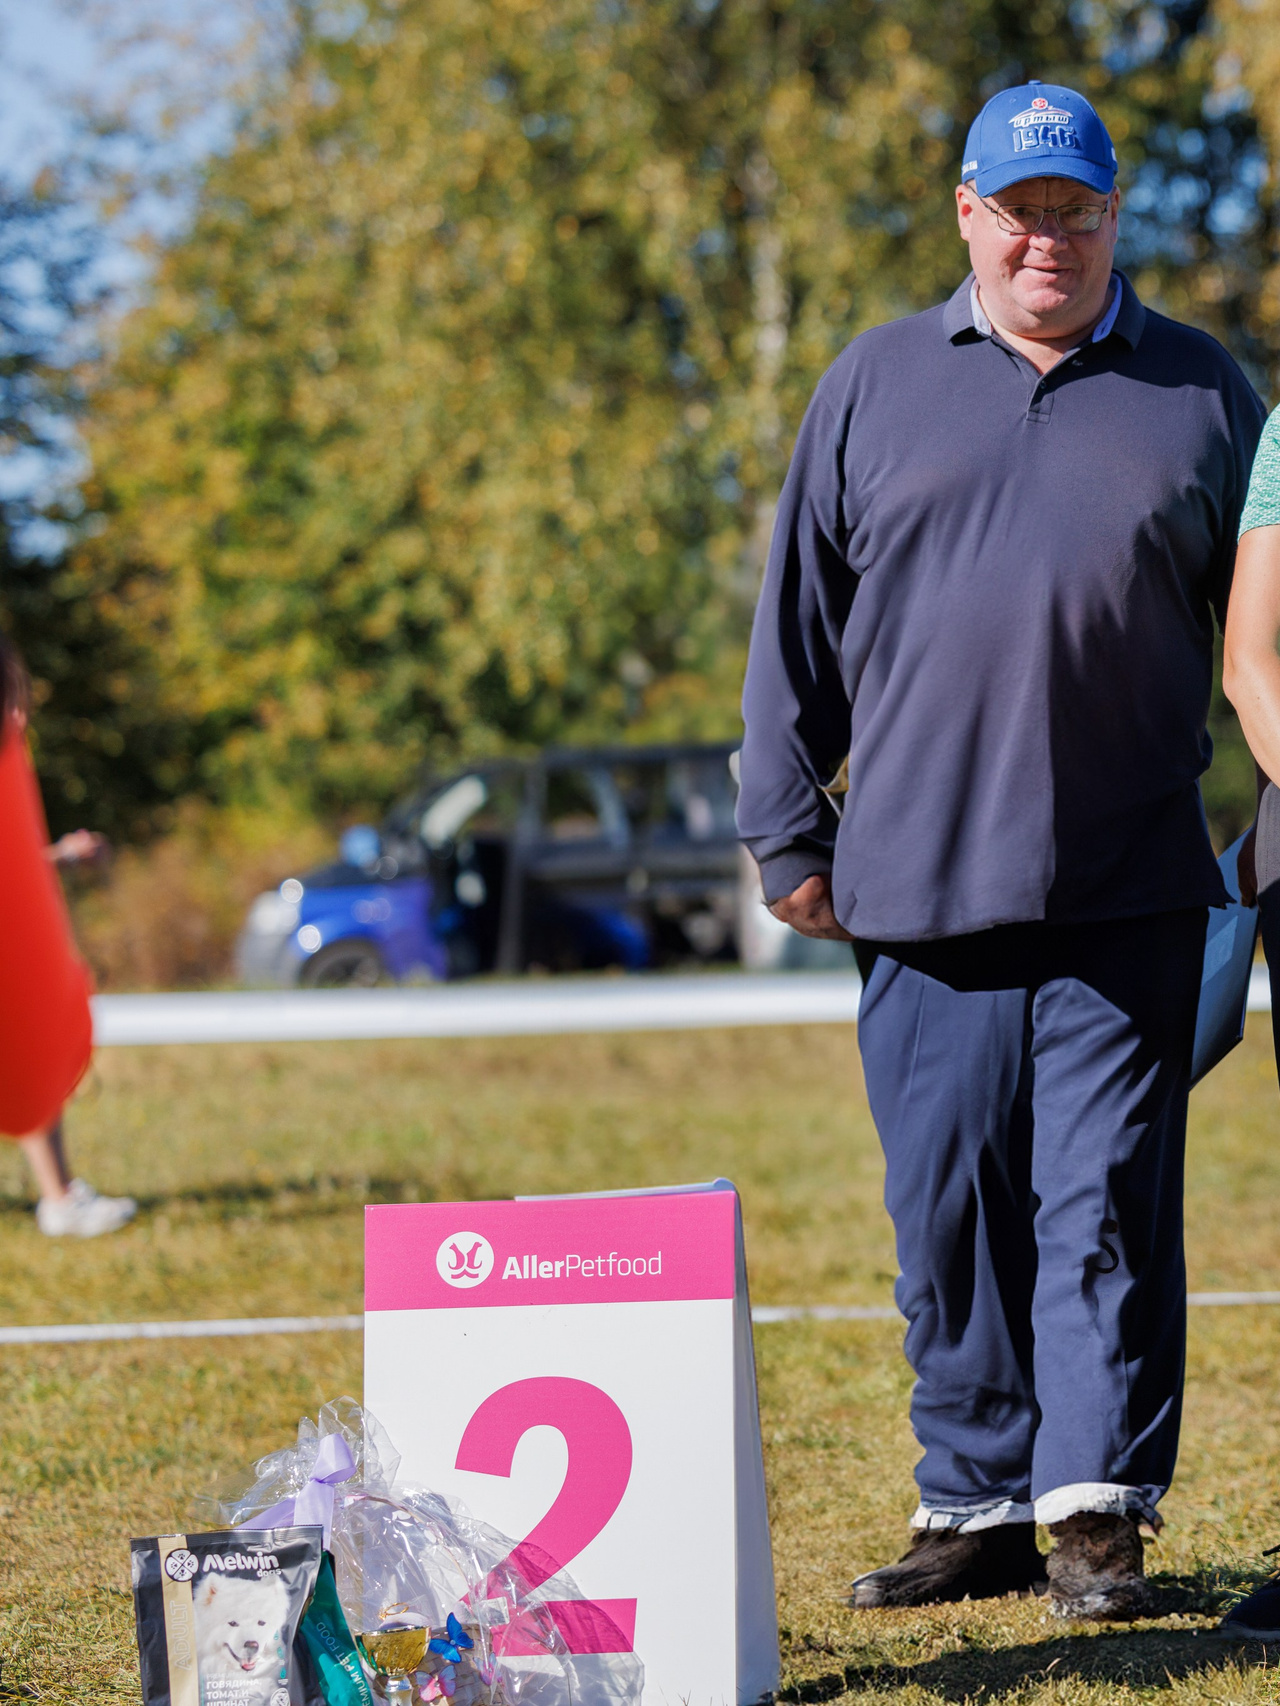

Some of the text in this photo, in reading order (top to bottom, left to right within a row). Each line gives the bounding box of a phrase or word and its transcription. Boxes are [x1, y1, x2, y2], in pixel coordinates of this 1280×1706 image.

[1013, 125, 1076, 152] 1946
[502, 1250, 662, 1280] AllerPetfood
[455, 1376, 638, 1657] 2
[203, 1551, 279, 1573] Melwin
[169, 1600, 193, 1671] ADULT
[316, 1621, 340, 1652] FOOD
[335, 1652, 355, 1672] PET
